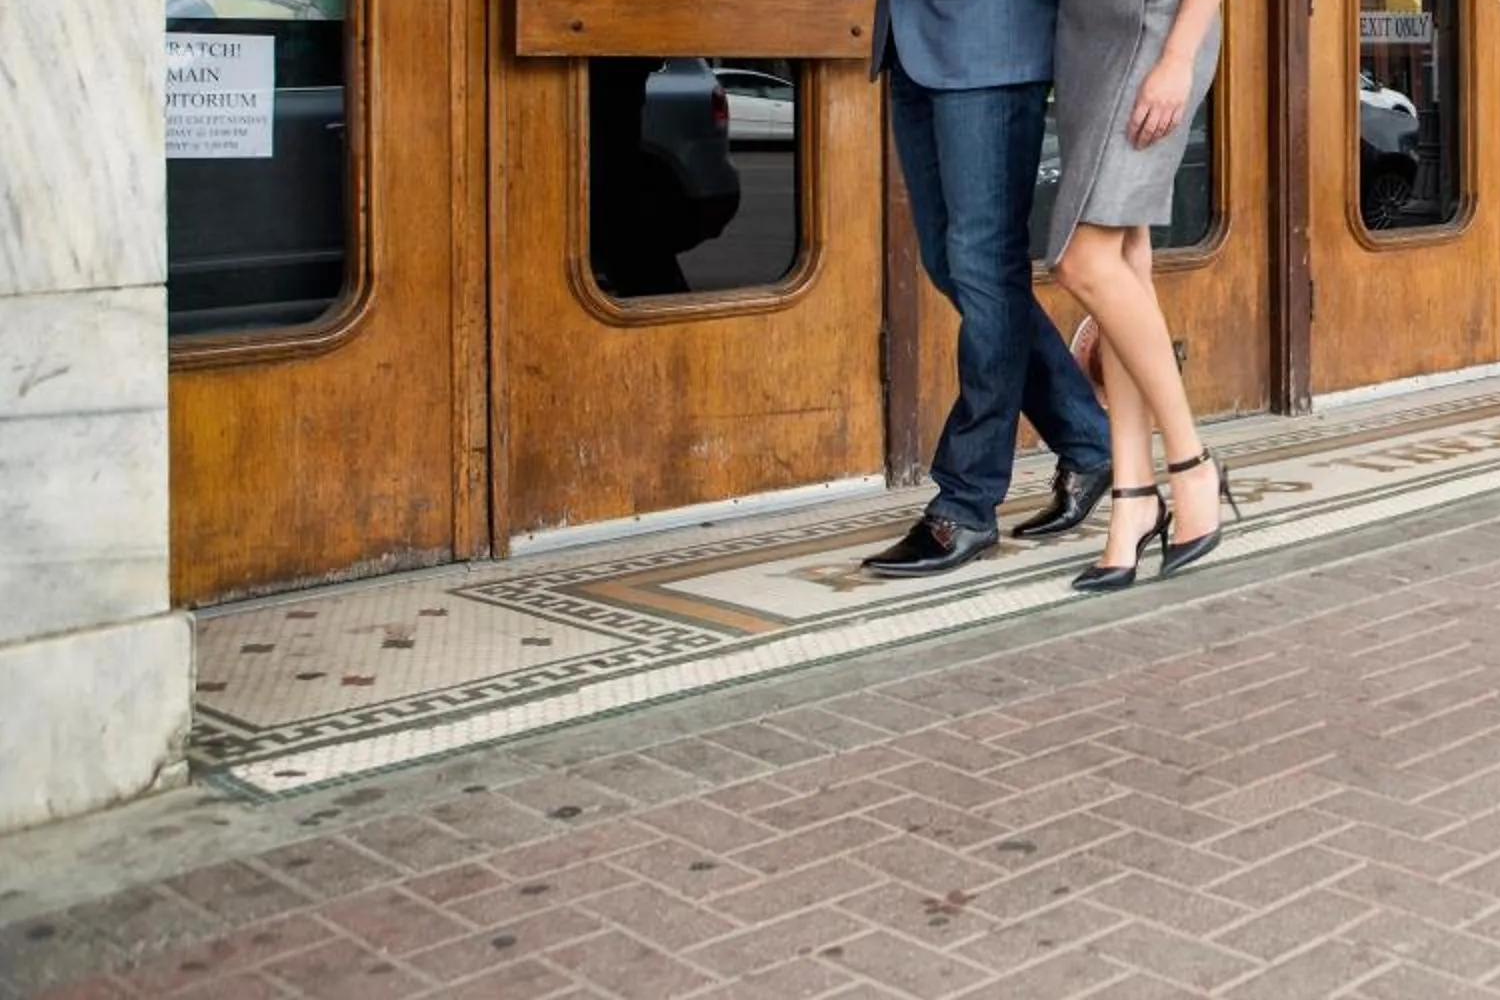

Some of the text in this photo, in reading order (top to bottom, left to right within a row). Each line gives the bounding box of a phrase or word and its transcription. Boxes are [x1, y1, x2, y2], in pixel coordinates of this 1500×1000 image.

[1360, 13, 1430, 39] EXIT ONLY
[167, 67, 221, 83] MAIN
